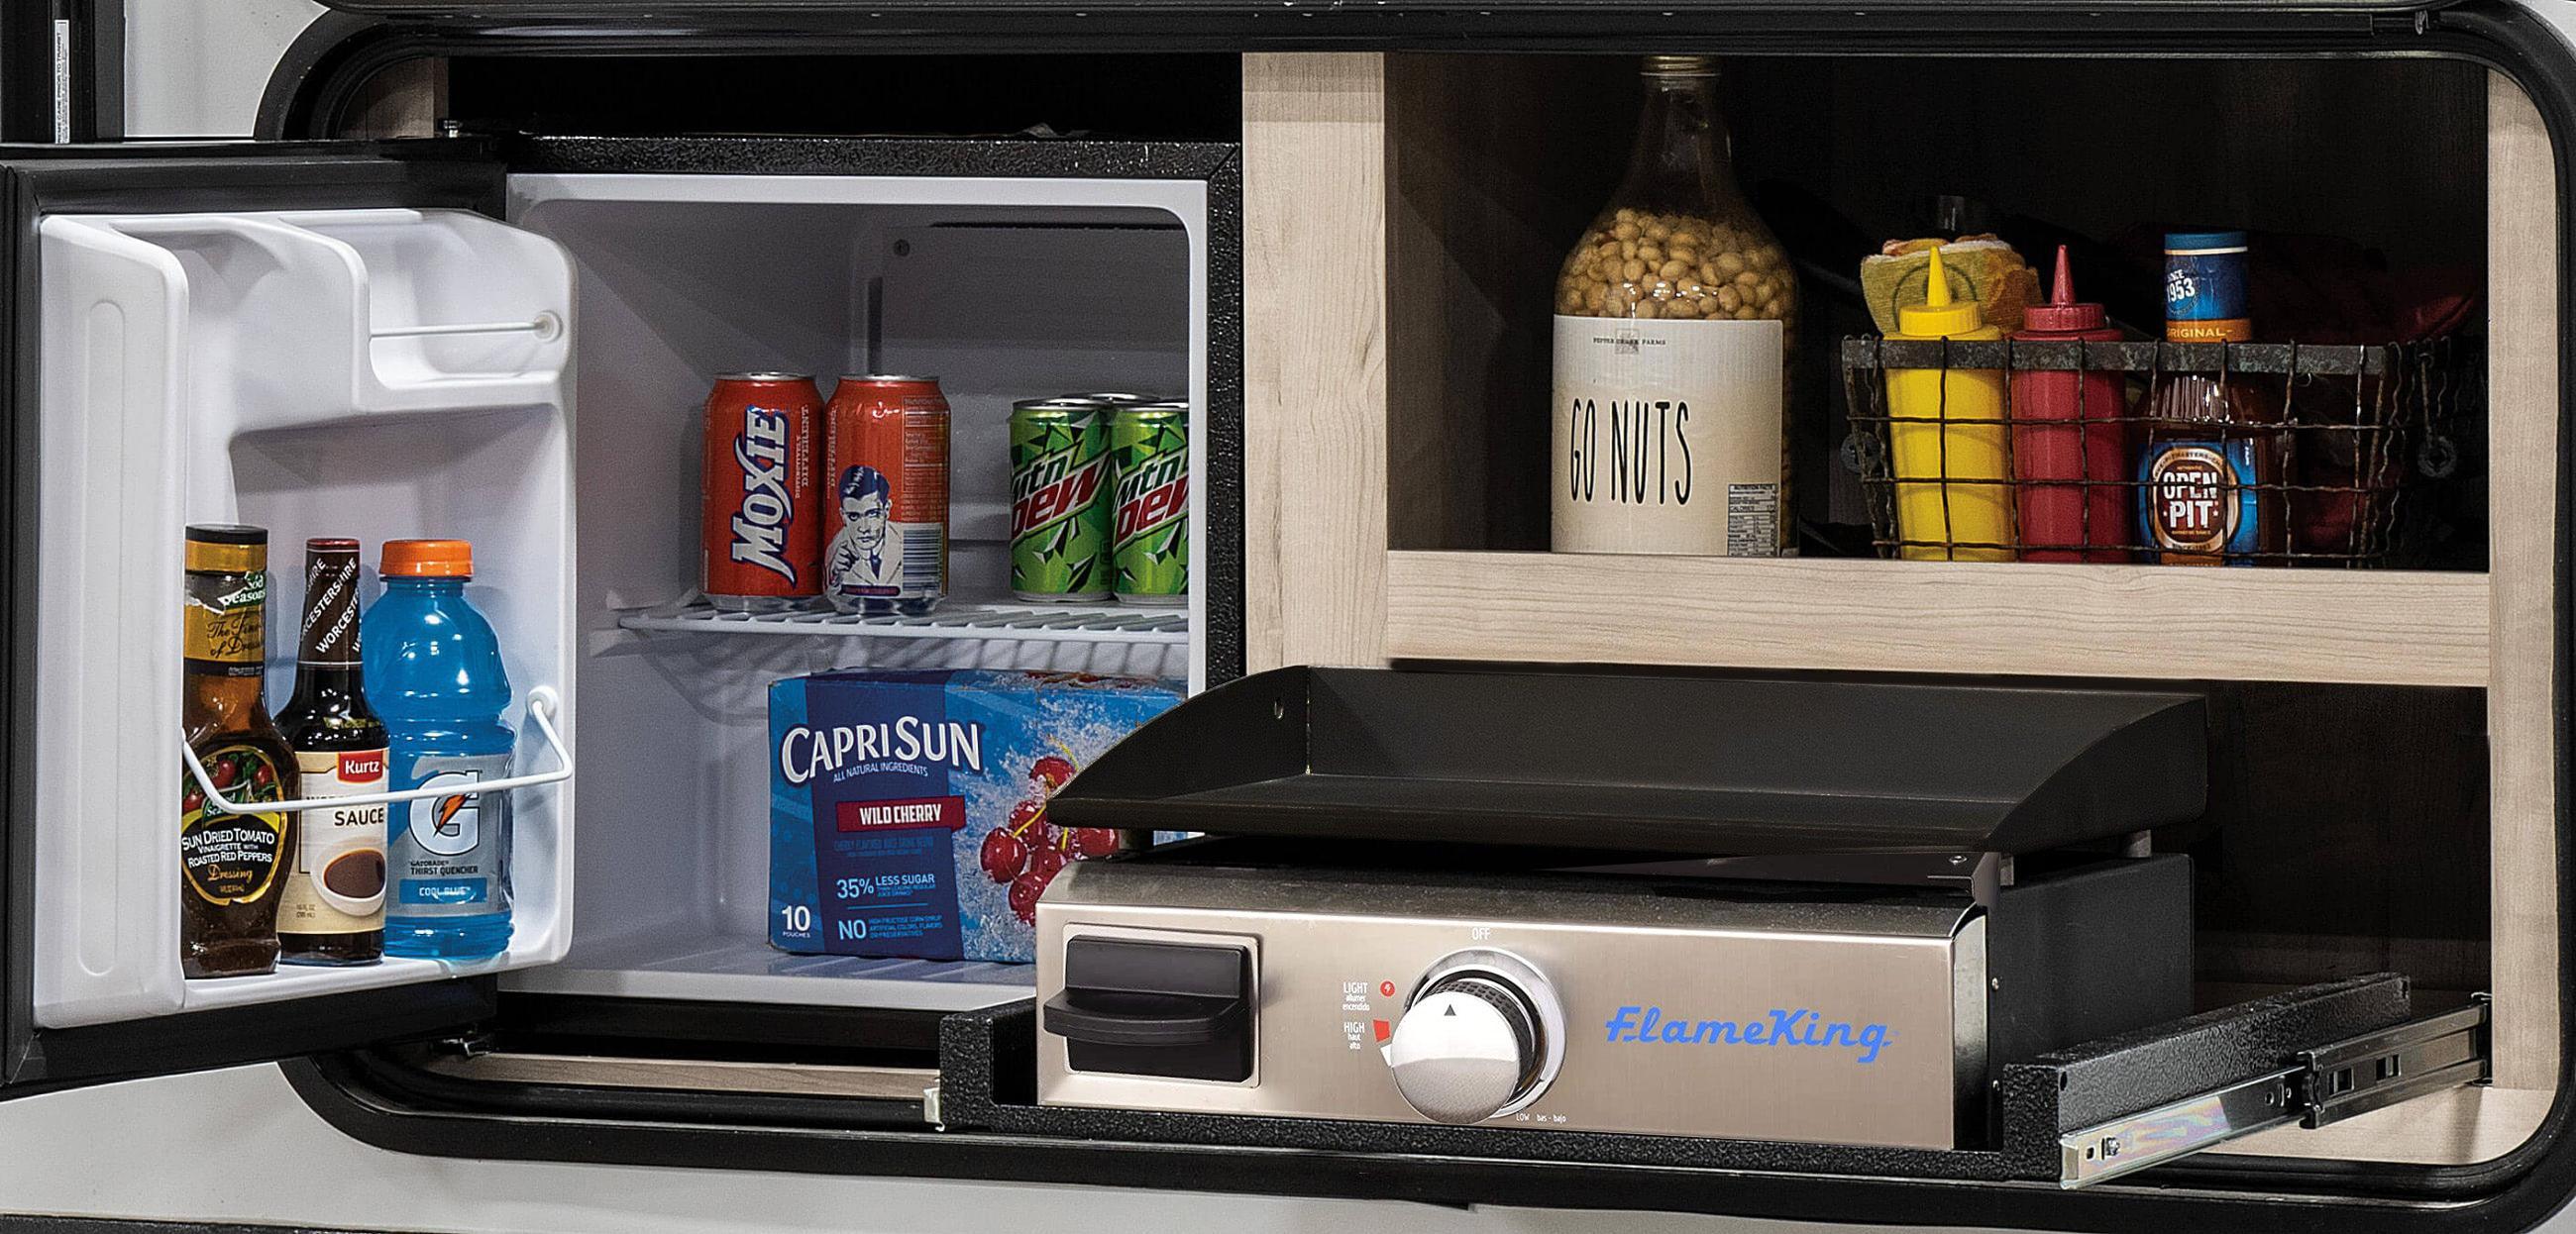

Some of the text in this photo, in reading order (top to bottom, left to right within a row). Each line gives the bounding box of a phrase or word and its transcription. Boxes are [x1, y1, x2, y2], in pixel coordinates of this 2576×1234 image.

[2167, 277, 2196, 303] 1953
[1569, 397, 1692, 505] GO NUTS
[732, 404, 796, 586] MOXIE
[2163, 471, 2217, 499] OPEN
[2170, 500, 2213, 528] PIT
[345, 760, 379, 774] Kurtz
[833, 761, 928, 783] ALL NATURAL INGREDIENTS
[334, 807, 384, 827] SAUCE
[859, 803, 942, 825] WILD CHERRY
[181, 827, 275, 851] SUN DRIED TOMATO
[187, 851, 273, 869] ROASTED RED PEPPERS
[207, 864, 254, 883] Dressing
[410, 867, 437, 875] THIRST
[875, 874, 935, 886] LESS SUGAR
[836, 877, 875, 898] 35%
[782, 905, 811, 931] 10
[838, 919, 867, 940] NO
[1471, 927, 1491, 940] OFF
[1342, 982, 1368, 993] LIGHT
[1343, 1022, 1365, 1033] HIGH
[1605, 1005, 1890, 1064] FlameKing
[1516, 1113, 1530, 1122] LOW
